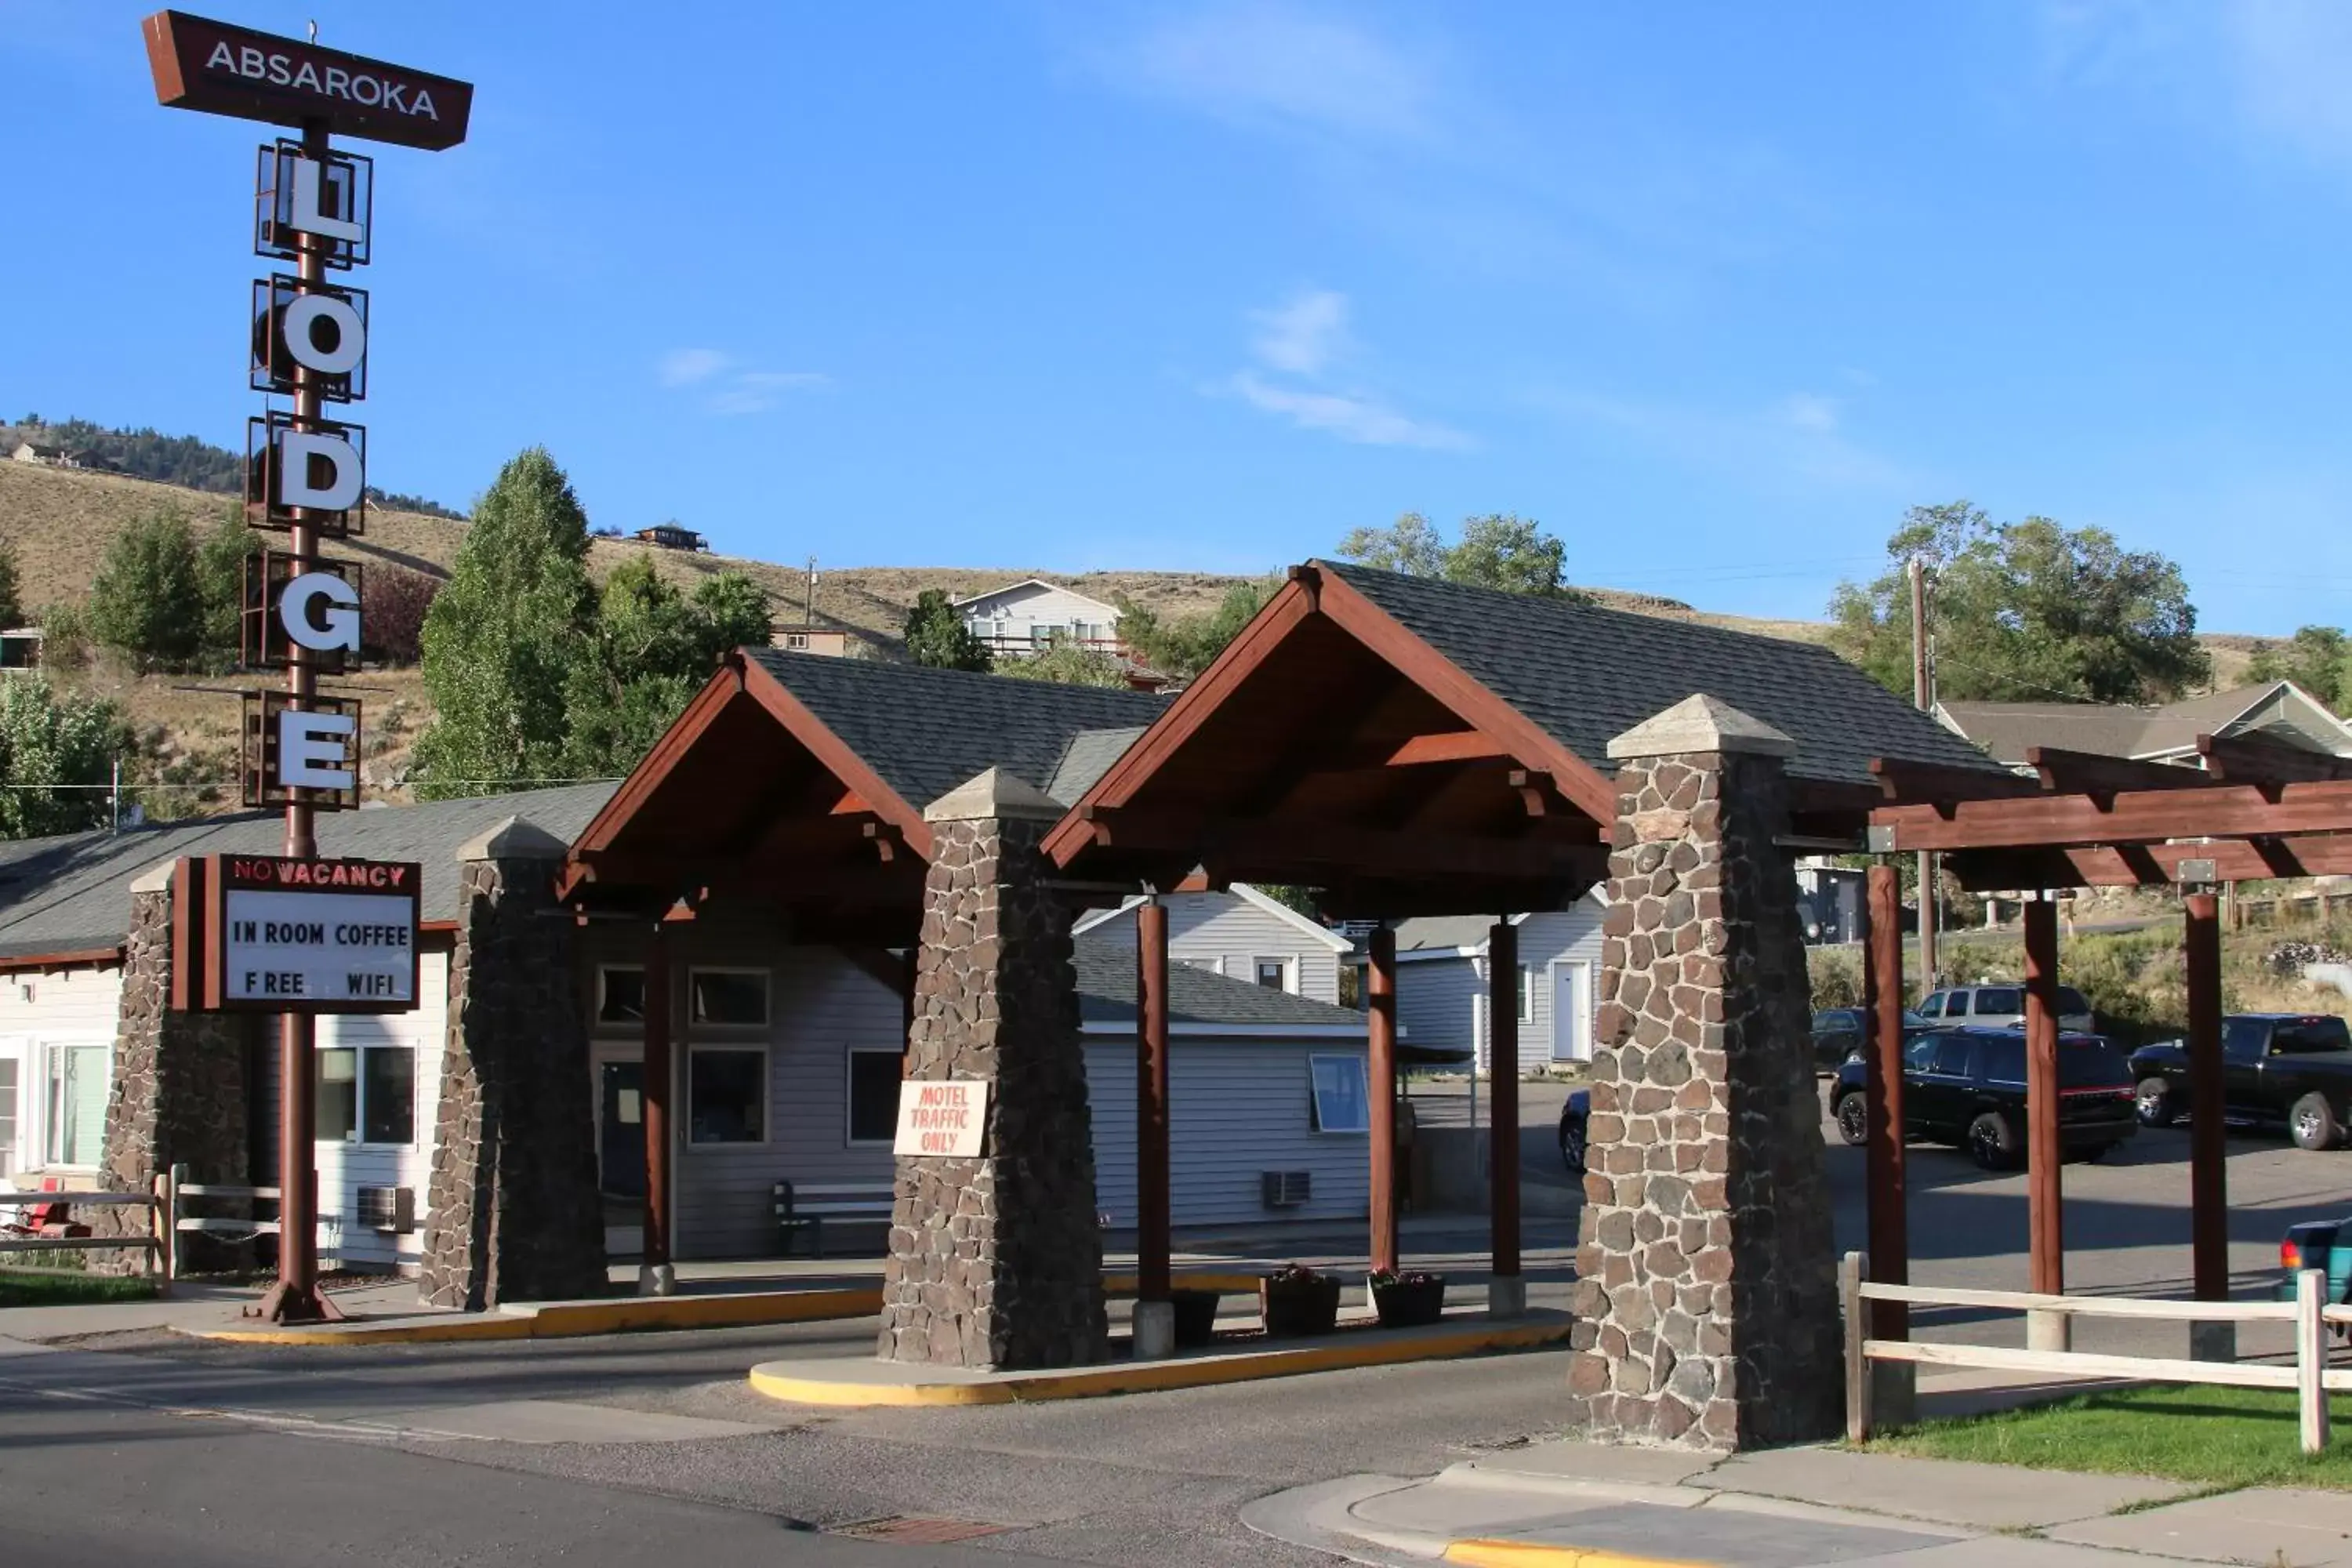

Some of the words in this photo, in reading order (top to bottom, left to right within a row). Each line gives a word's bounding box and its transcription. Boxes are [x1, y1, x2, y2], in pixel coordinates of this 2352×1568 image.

[206, 42, 439, 122] ABSAROKA
[278, 156, 366, 790] LODGE
[235, 861, 272, 880] NO
[276, 862, 405, 887] VACANCY
[234, 920, 256, 942] IN
[265, 923, 324, 945] ROOM
[335, 924, 408, 946] COFFEE
[245, 971, 303, 994] FREE
[347, 973, 394, 995] WIFI
[920, 1086, 969, 1107] MOTEL
[911, 1109, 969, 1130] TRAFFIC
[920, 1131, 958, 1152] ONLY
